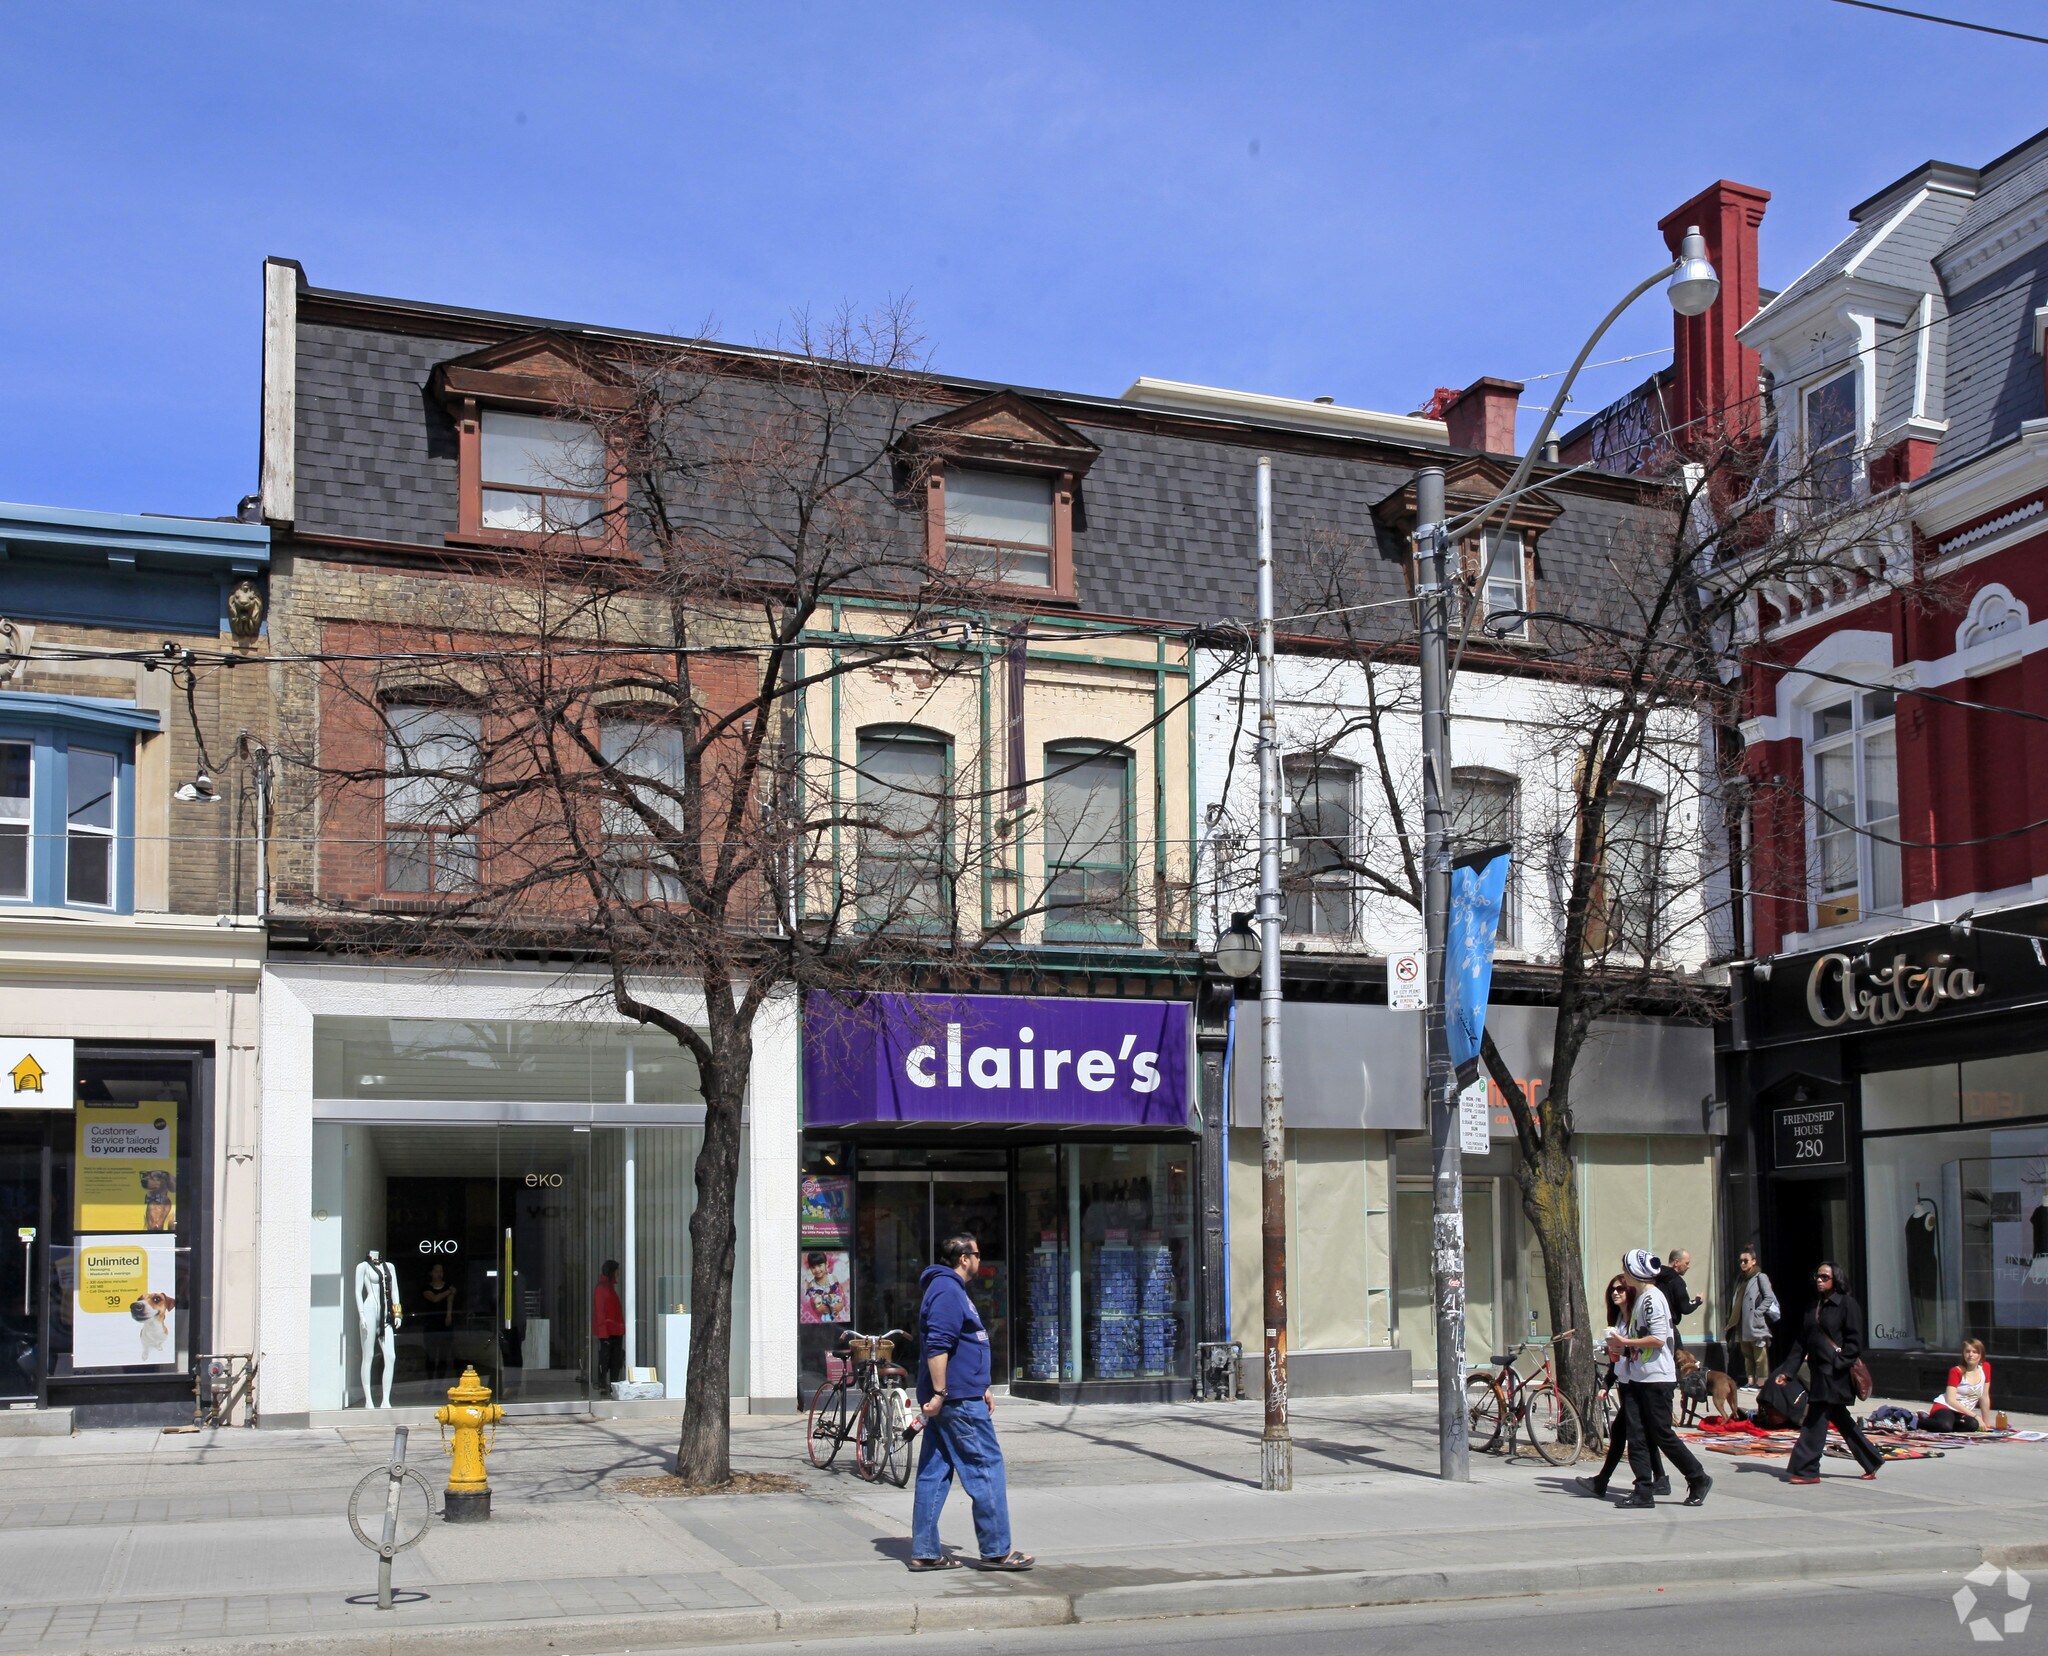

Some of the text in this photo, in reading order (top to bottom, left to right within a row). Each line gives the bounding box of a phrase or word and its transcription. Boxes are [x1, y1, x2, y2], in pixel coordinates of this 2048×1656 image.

[1806, 953, 1985, 1027] Aritzia
[905, 1022, 1161, 1093] claire's
[1783, 1110, 1835, 1125] FRIENDSHIP
[91, 1126, 137, 1136] Customer
[1794, 1124, 1824, 1137] HOUSE
[91, 1136, 160, 1145] service tailored
[91, 1145, 158, 1155] to your needs
[1796, 1138, 1824, 1158] 280
[525, 1173, 563, 1188] eko
[419, 1240, 458, 1254] eko
[87, 1256, 140, 1267] Unlimited
